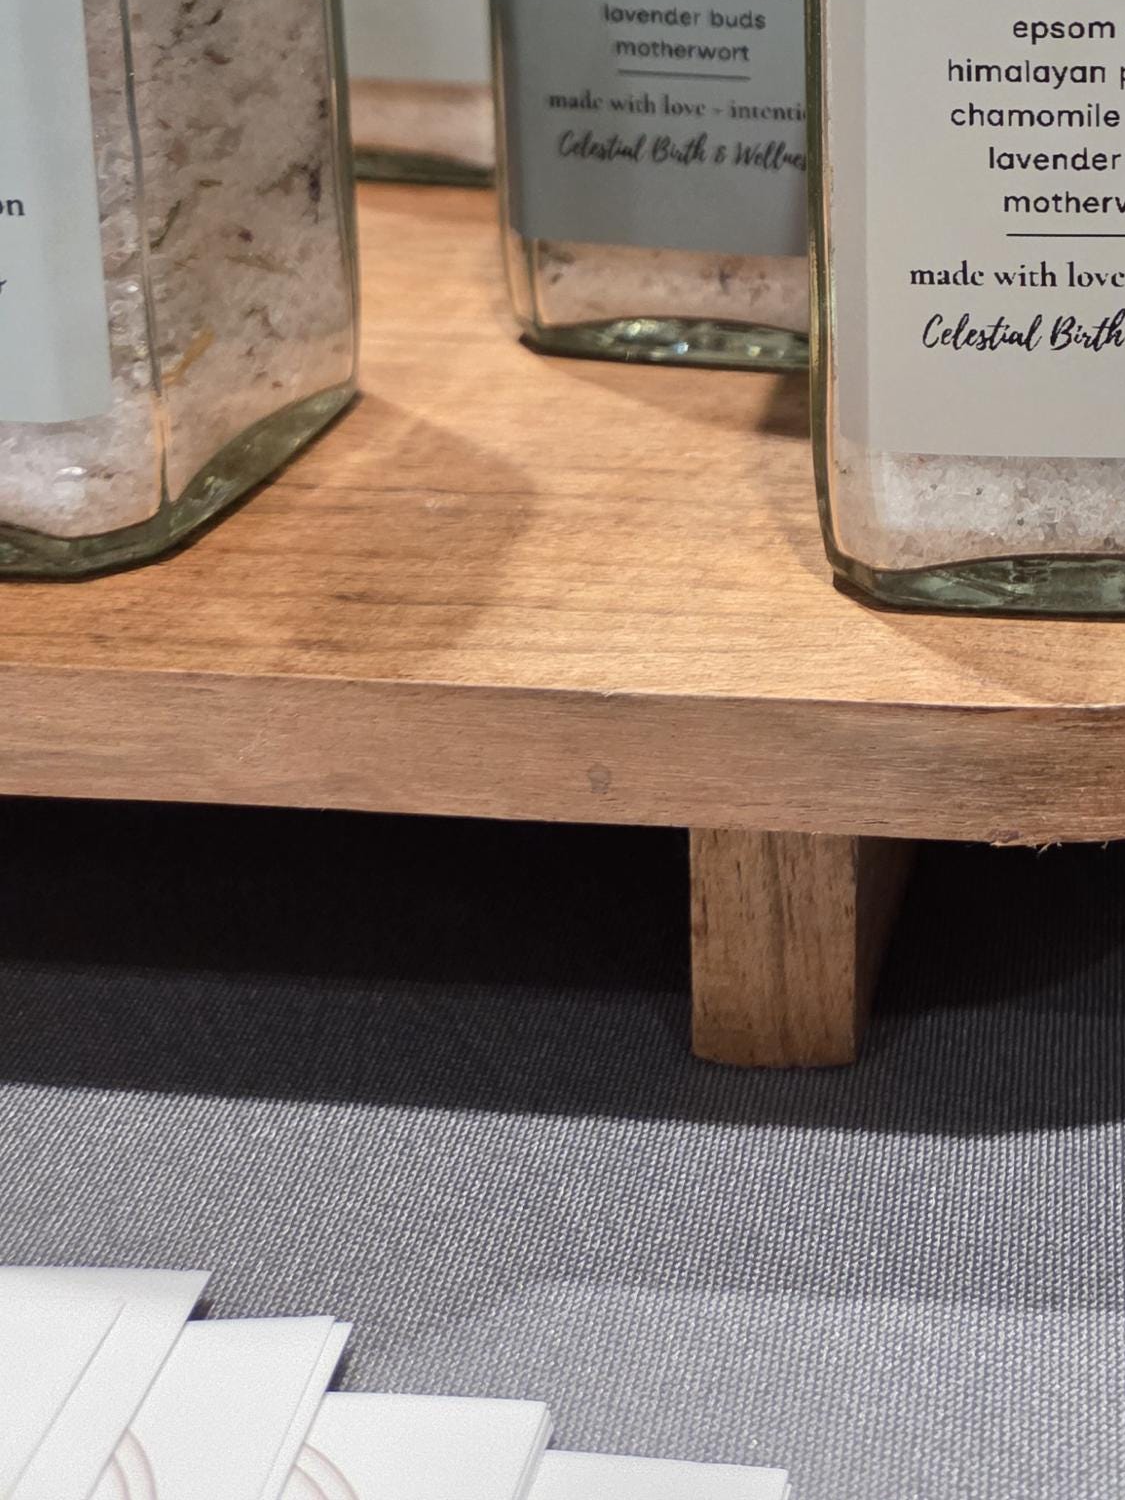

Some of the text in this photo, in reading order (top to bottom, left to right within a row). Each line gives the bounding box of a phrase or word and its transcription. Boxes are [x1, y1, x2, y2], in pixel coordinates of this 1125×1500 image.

[603, 3, 766, 31] lavender buds
[1012, 20, 1116, 46] epsom
[614, 40, 750, 62] motherwort
[948, 58, 1106, 90] himalayan
[548, 89, 604, 111] made
[610, 94, 657, 115] with
[661, 93, 706, 117] love
[950, 102, 1121, 128] chamomile
[559, 131, 645, 164] Celestial
[652, 132, 708, 165] Birth
[989, 146, 1122, 172] lavender
[909, 259, 985, 287] made
[993, 260, 1058, 288] with
[1067, 260, 1125, 288] love
[922, 312, 1043, 352] Celestial
